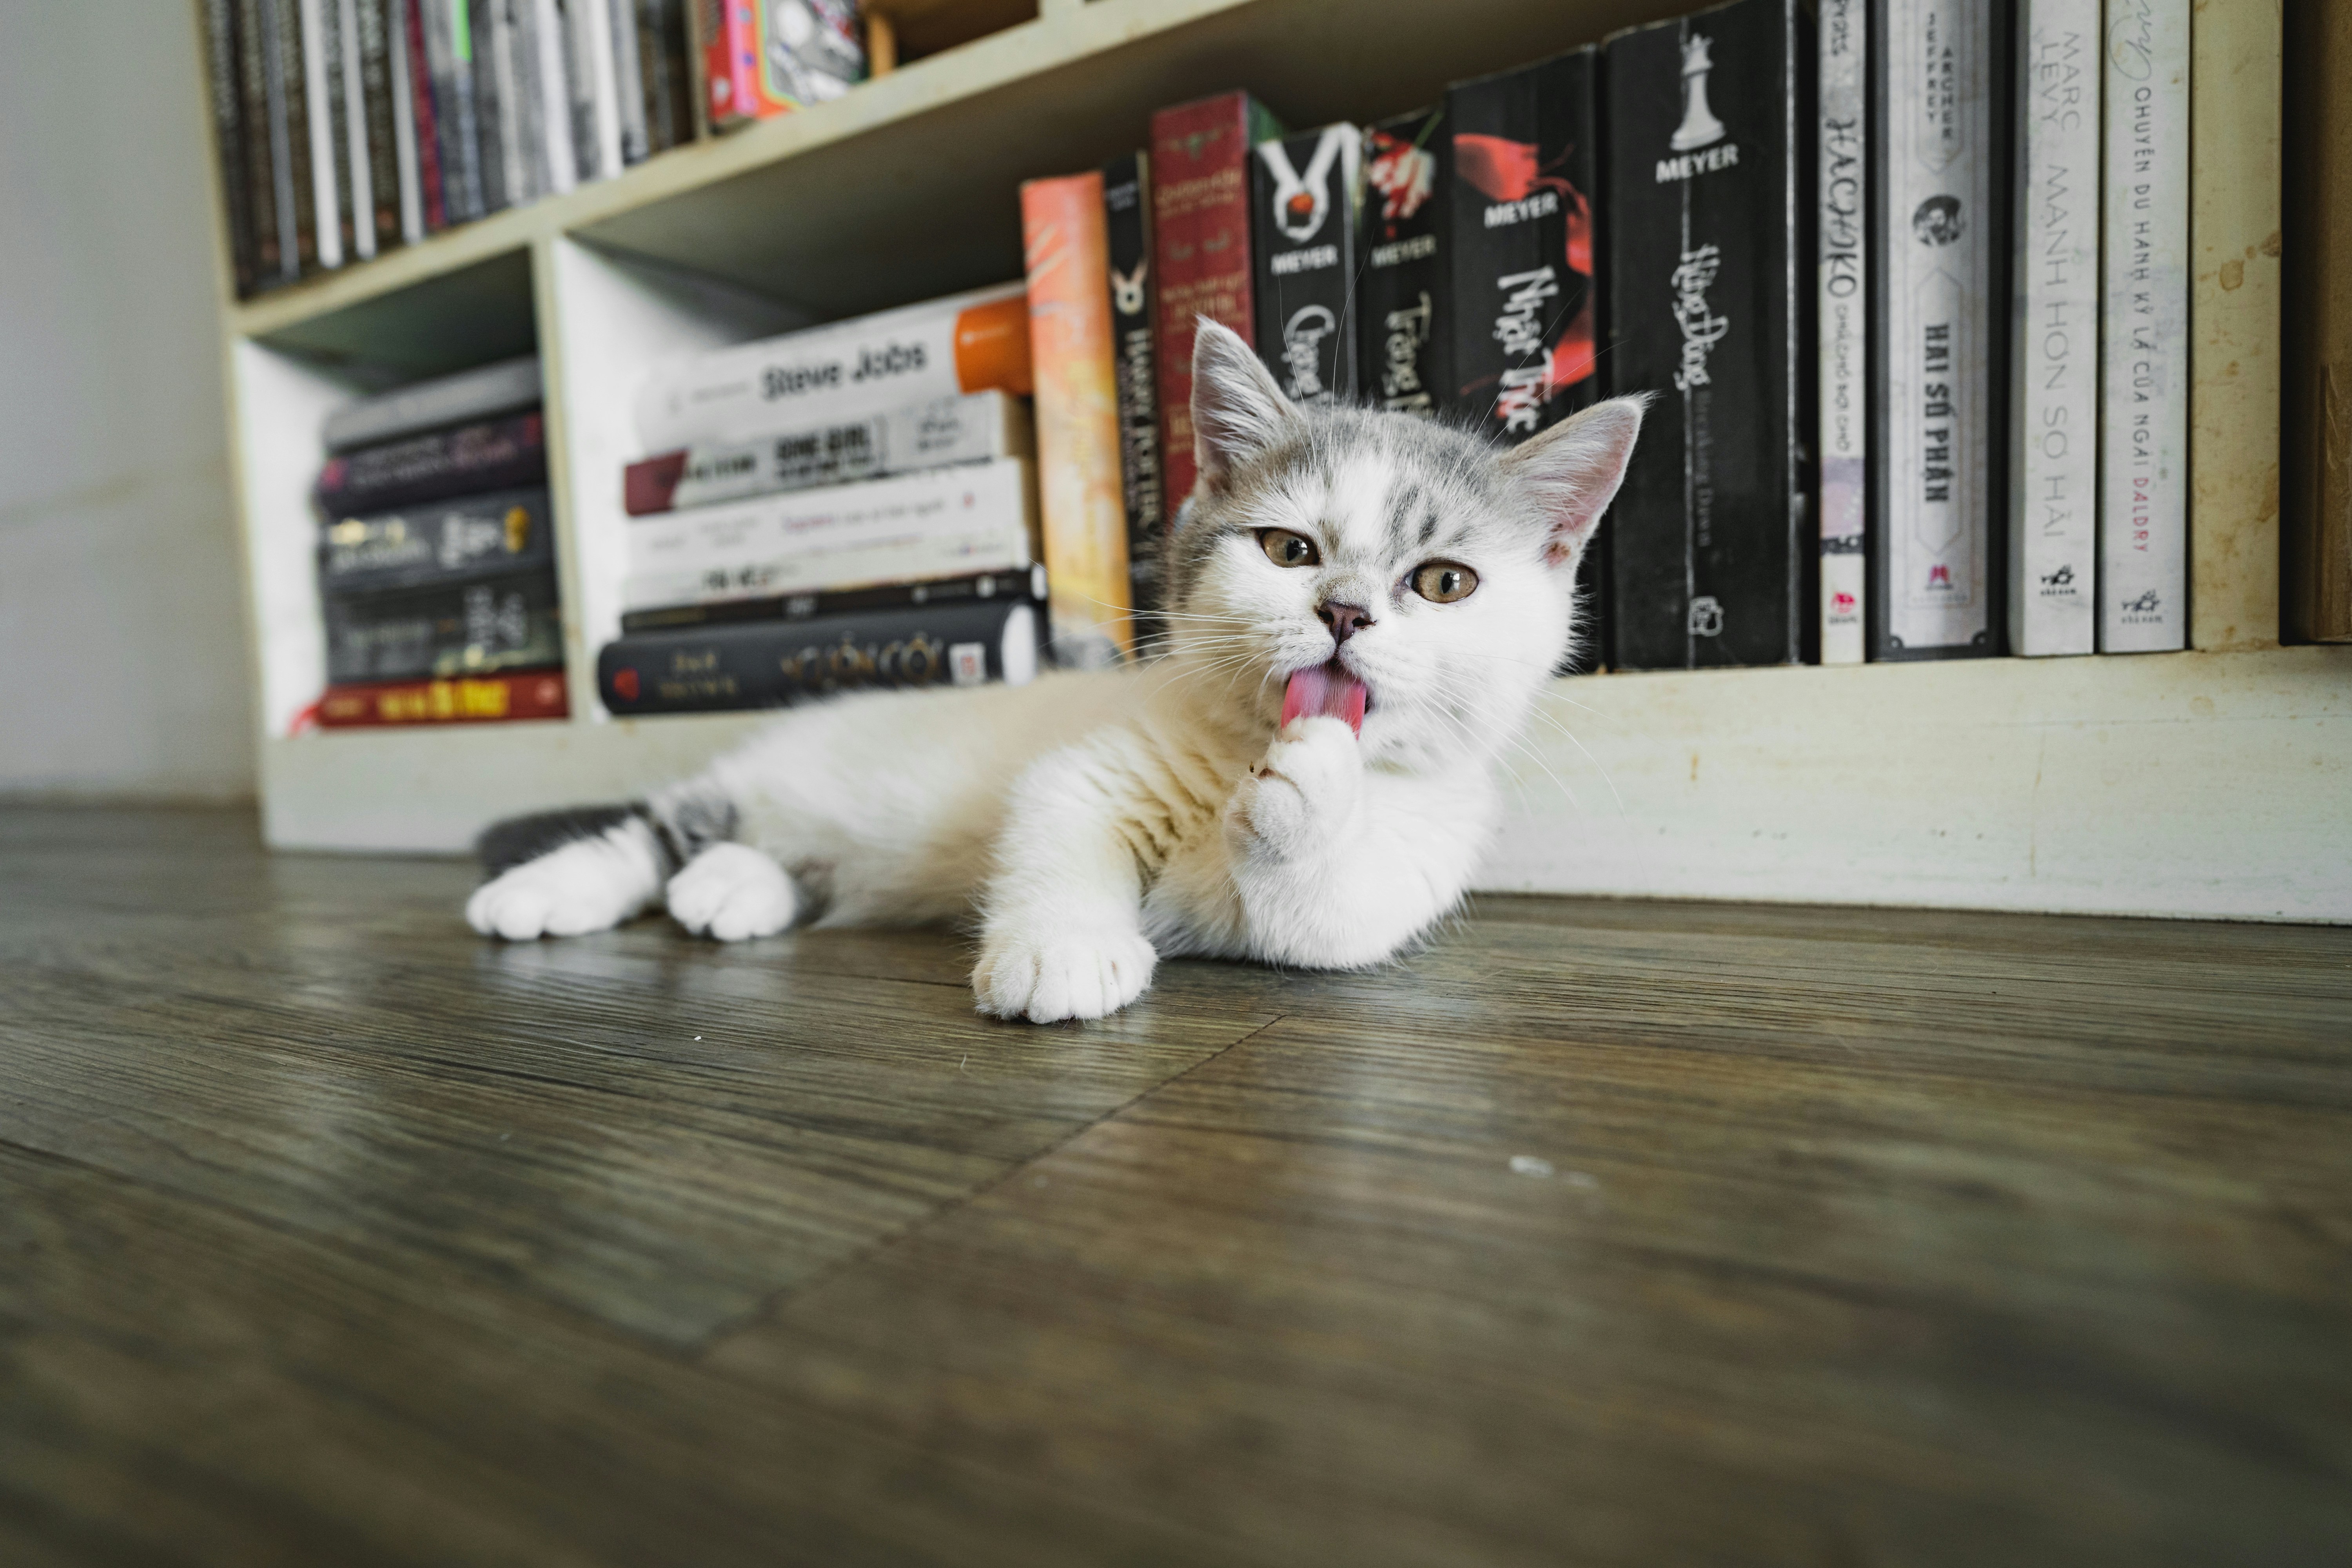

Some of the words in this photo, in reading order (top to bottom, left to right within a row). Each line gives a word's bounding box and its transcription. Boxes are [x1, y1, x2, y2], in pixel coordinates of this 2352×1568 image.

[1942, 47, 1955, 140] ARCHER
[2040, 41, 2060, 124] LEVY
[2061, 31, 2081, 131] MARC
[1655, 143, 1739, 183] MEYER
[1484, 191, 1559, 228] MEYER
[1825, 118, 1858, 298] HACHIKO
[2041, 164, 2069, 286] MẠNH
[2134, 183, 2151, 210] DU
[1270, 243, 1338, 276] MEYER
[1370, 235, 1437, 268] MEYER
[761, 361, 842, 401] Steve
[850, 342, 928, 384] Jobs
[1926, 323, 1949, 372] HAI
[2043, 300, 2070, 390] HƠN
[1925, 383, 1957, 417] SỐ
[1923, 428, 1955, 503] PHẬN
[2043, 475, 2072, 537] HÃI
[2132, 477, 2149, 552] DALDRY
